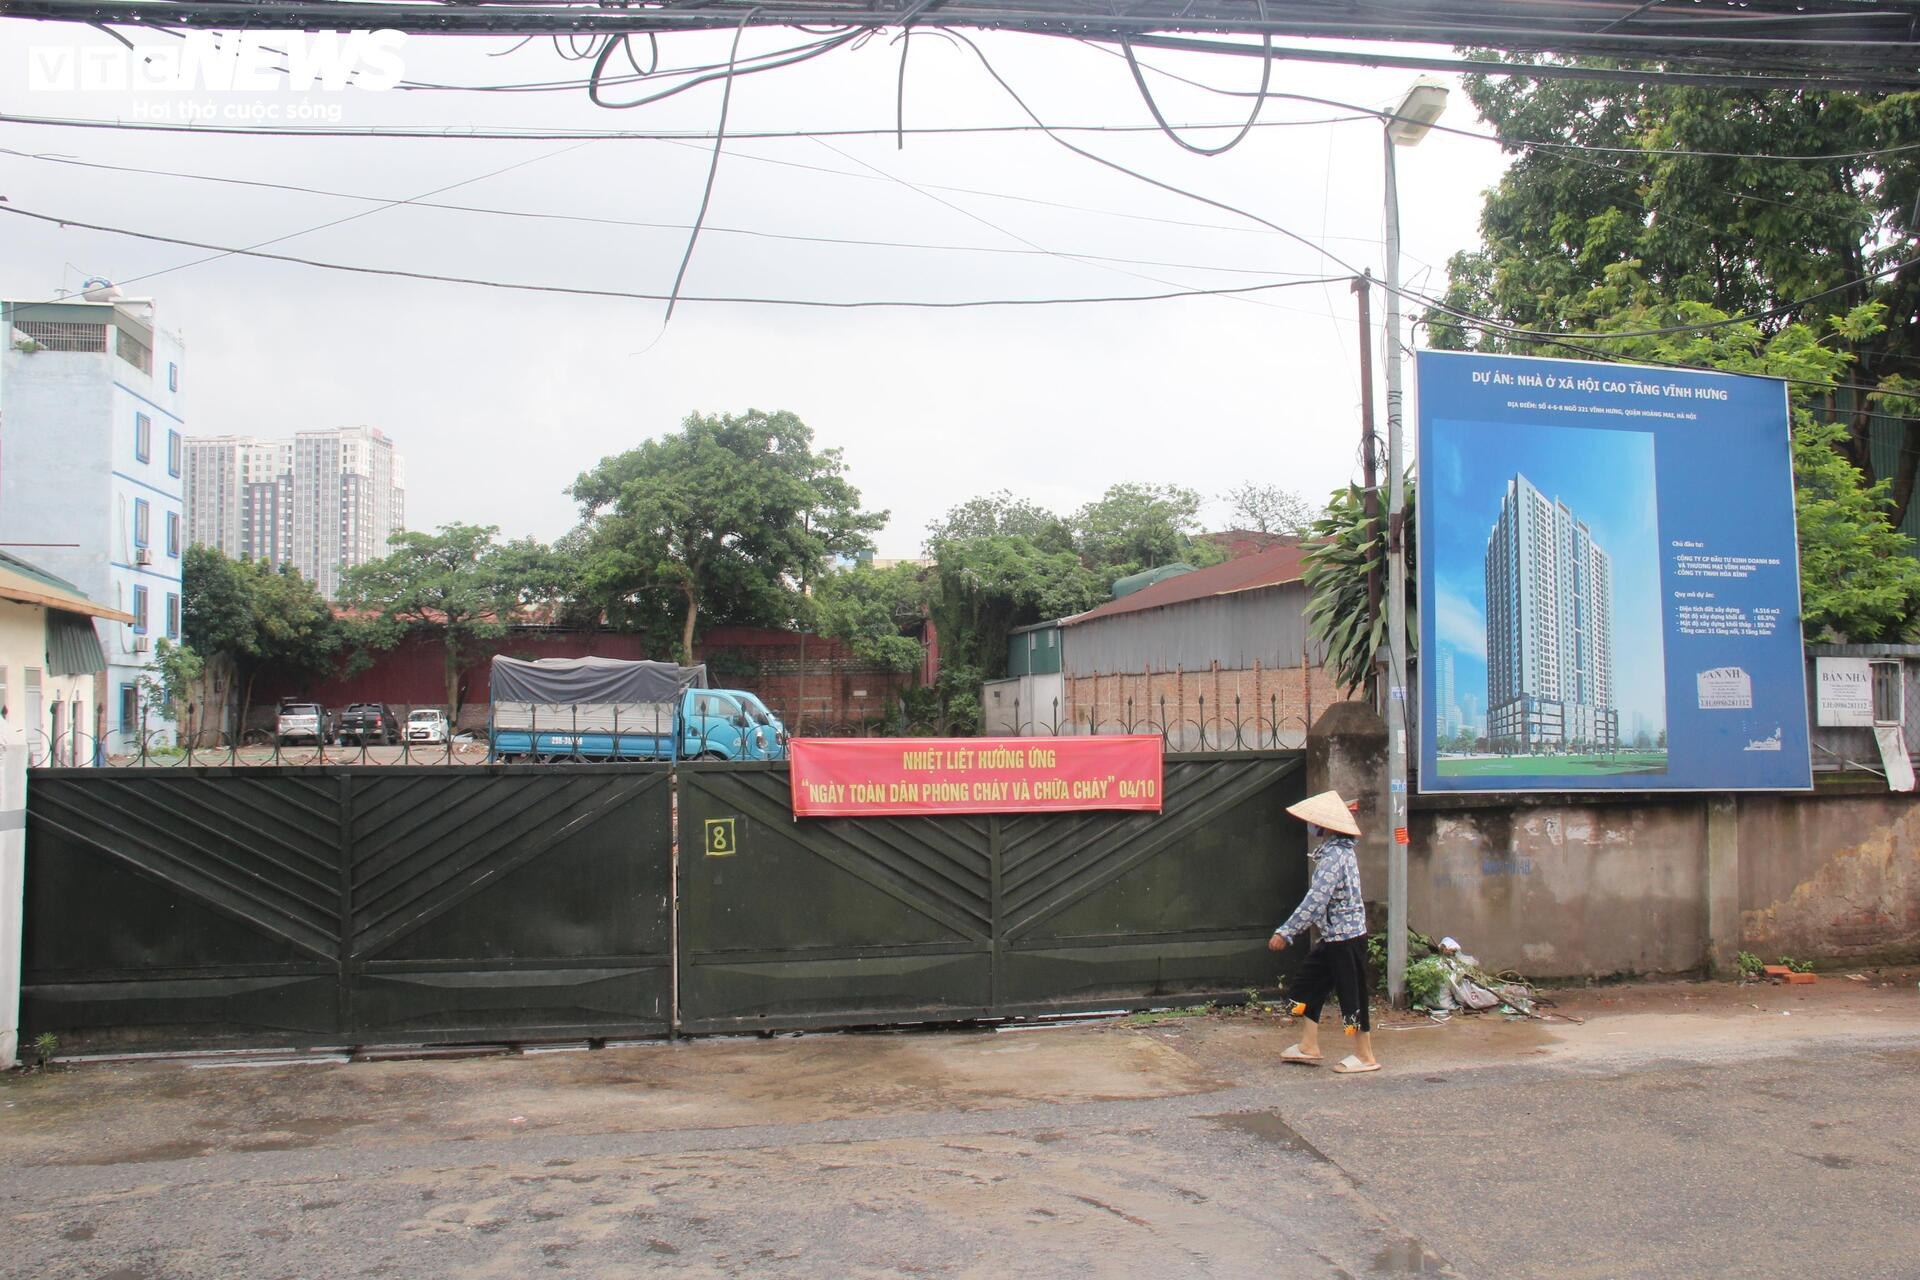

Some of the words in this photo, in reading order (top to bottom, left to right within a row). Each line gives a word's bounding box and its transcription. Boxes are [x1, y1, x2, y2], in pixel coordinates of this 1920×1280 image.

[1472, 370, 1491, 385] DỰ
[1494, 370, 1514, 384] ÁN:
[1517, 373, 1543, 387] NHÀ
[1546, 374, 1556, 388] Ở
[1558, 376, 1574, 390] XÃ
[1577, 377, 1600, 393] HỘI
[1602, 382, 1626, 393] CAO
[1628, 381, 1660, 395] TẦNG
[1662, 384, 1692, 397] VĨNH
[1695, 388, 1728, 400] HƯNG
[1725, 669, 1742, 679] NH
[903, 748, 943, 773] NHIỆT
[946, 747, 974, 773] LIỆT
[978, 744, 1024, 769] HƯỞNG
[1028, 746, 1056, 768] ỨNG
[849, 781, 886, 803] TOÀN
[890, 780, 919, 802] DÂN
[922, 779, 969, 802] PHÒNG
[973, 778, 1008, 801] CHÁY
[1012, 778, 1030, 800] VÀ
[1034, 777, 1069, 799] CHỮA
[1119, 779, 1154, 798] 04/10
[713, 826, 727, 849] 8
